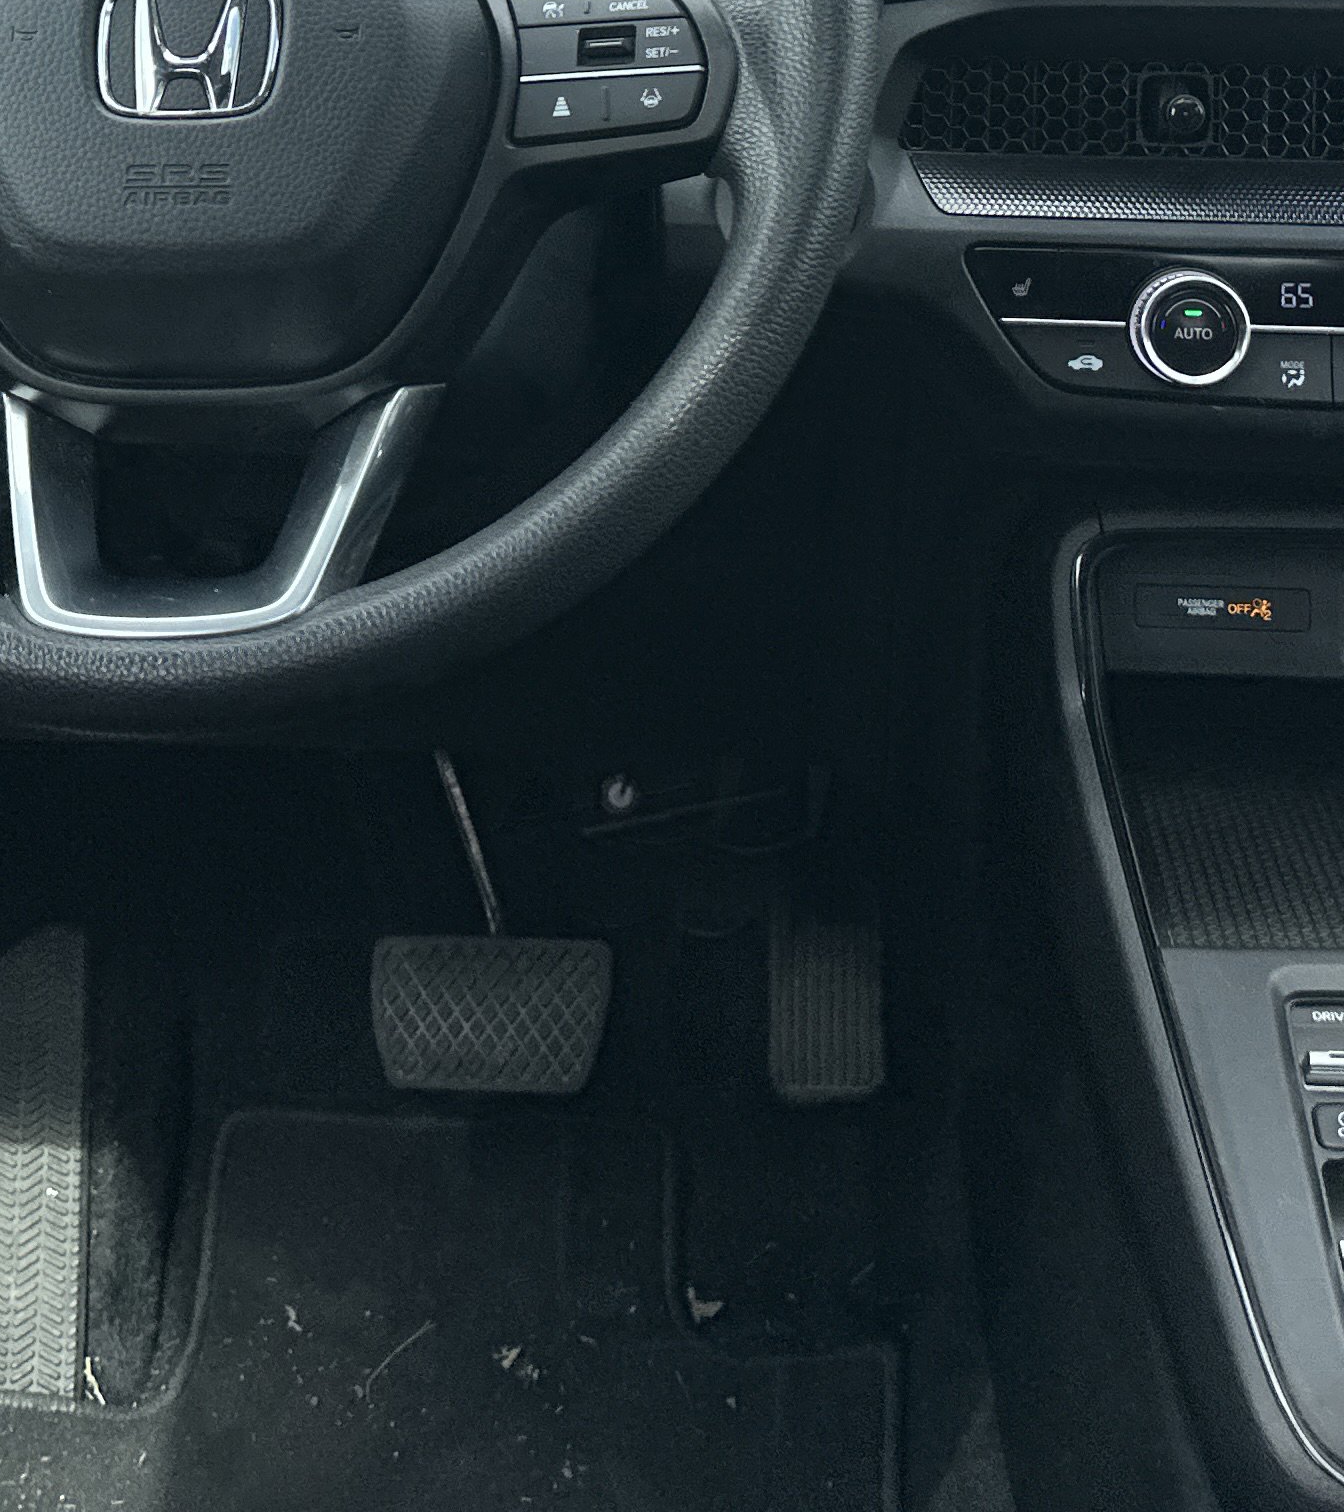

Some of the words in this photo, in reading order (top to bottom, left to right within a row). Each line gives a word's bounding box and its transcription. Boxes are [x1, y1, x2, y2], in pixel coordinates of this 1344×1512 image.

[609, 0, 649, 12] CANCEL
[125, 163, 231, 185] SRS
[123, 190, 232, 206] AIRBAG
[1280, 282, 1314, 309] 65
[1173, 326, 1213, 342] AUTO
[1280, 360, 1305, 371] MODE
[1177, 598, 1225, 608] PASSENGER
[1227, 603, 1252, 615] OFF
